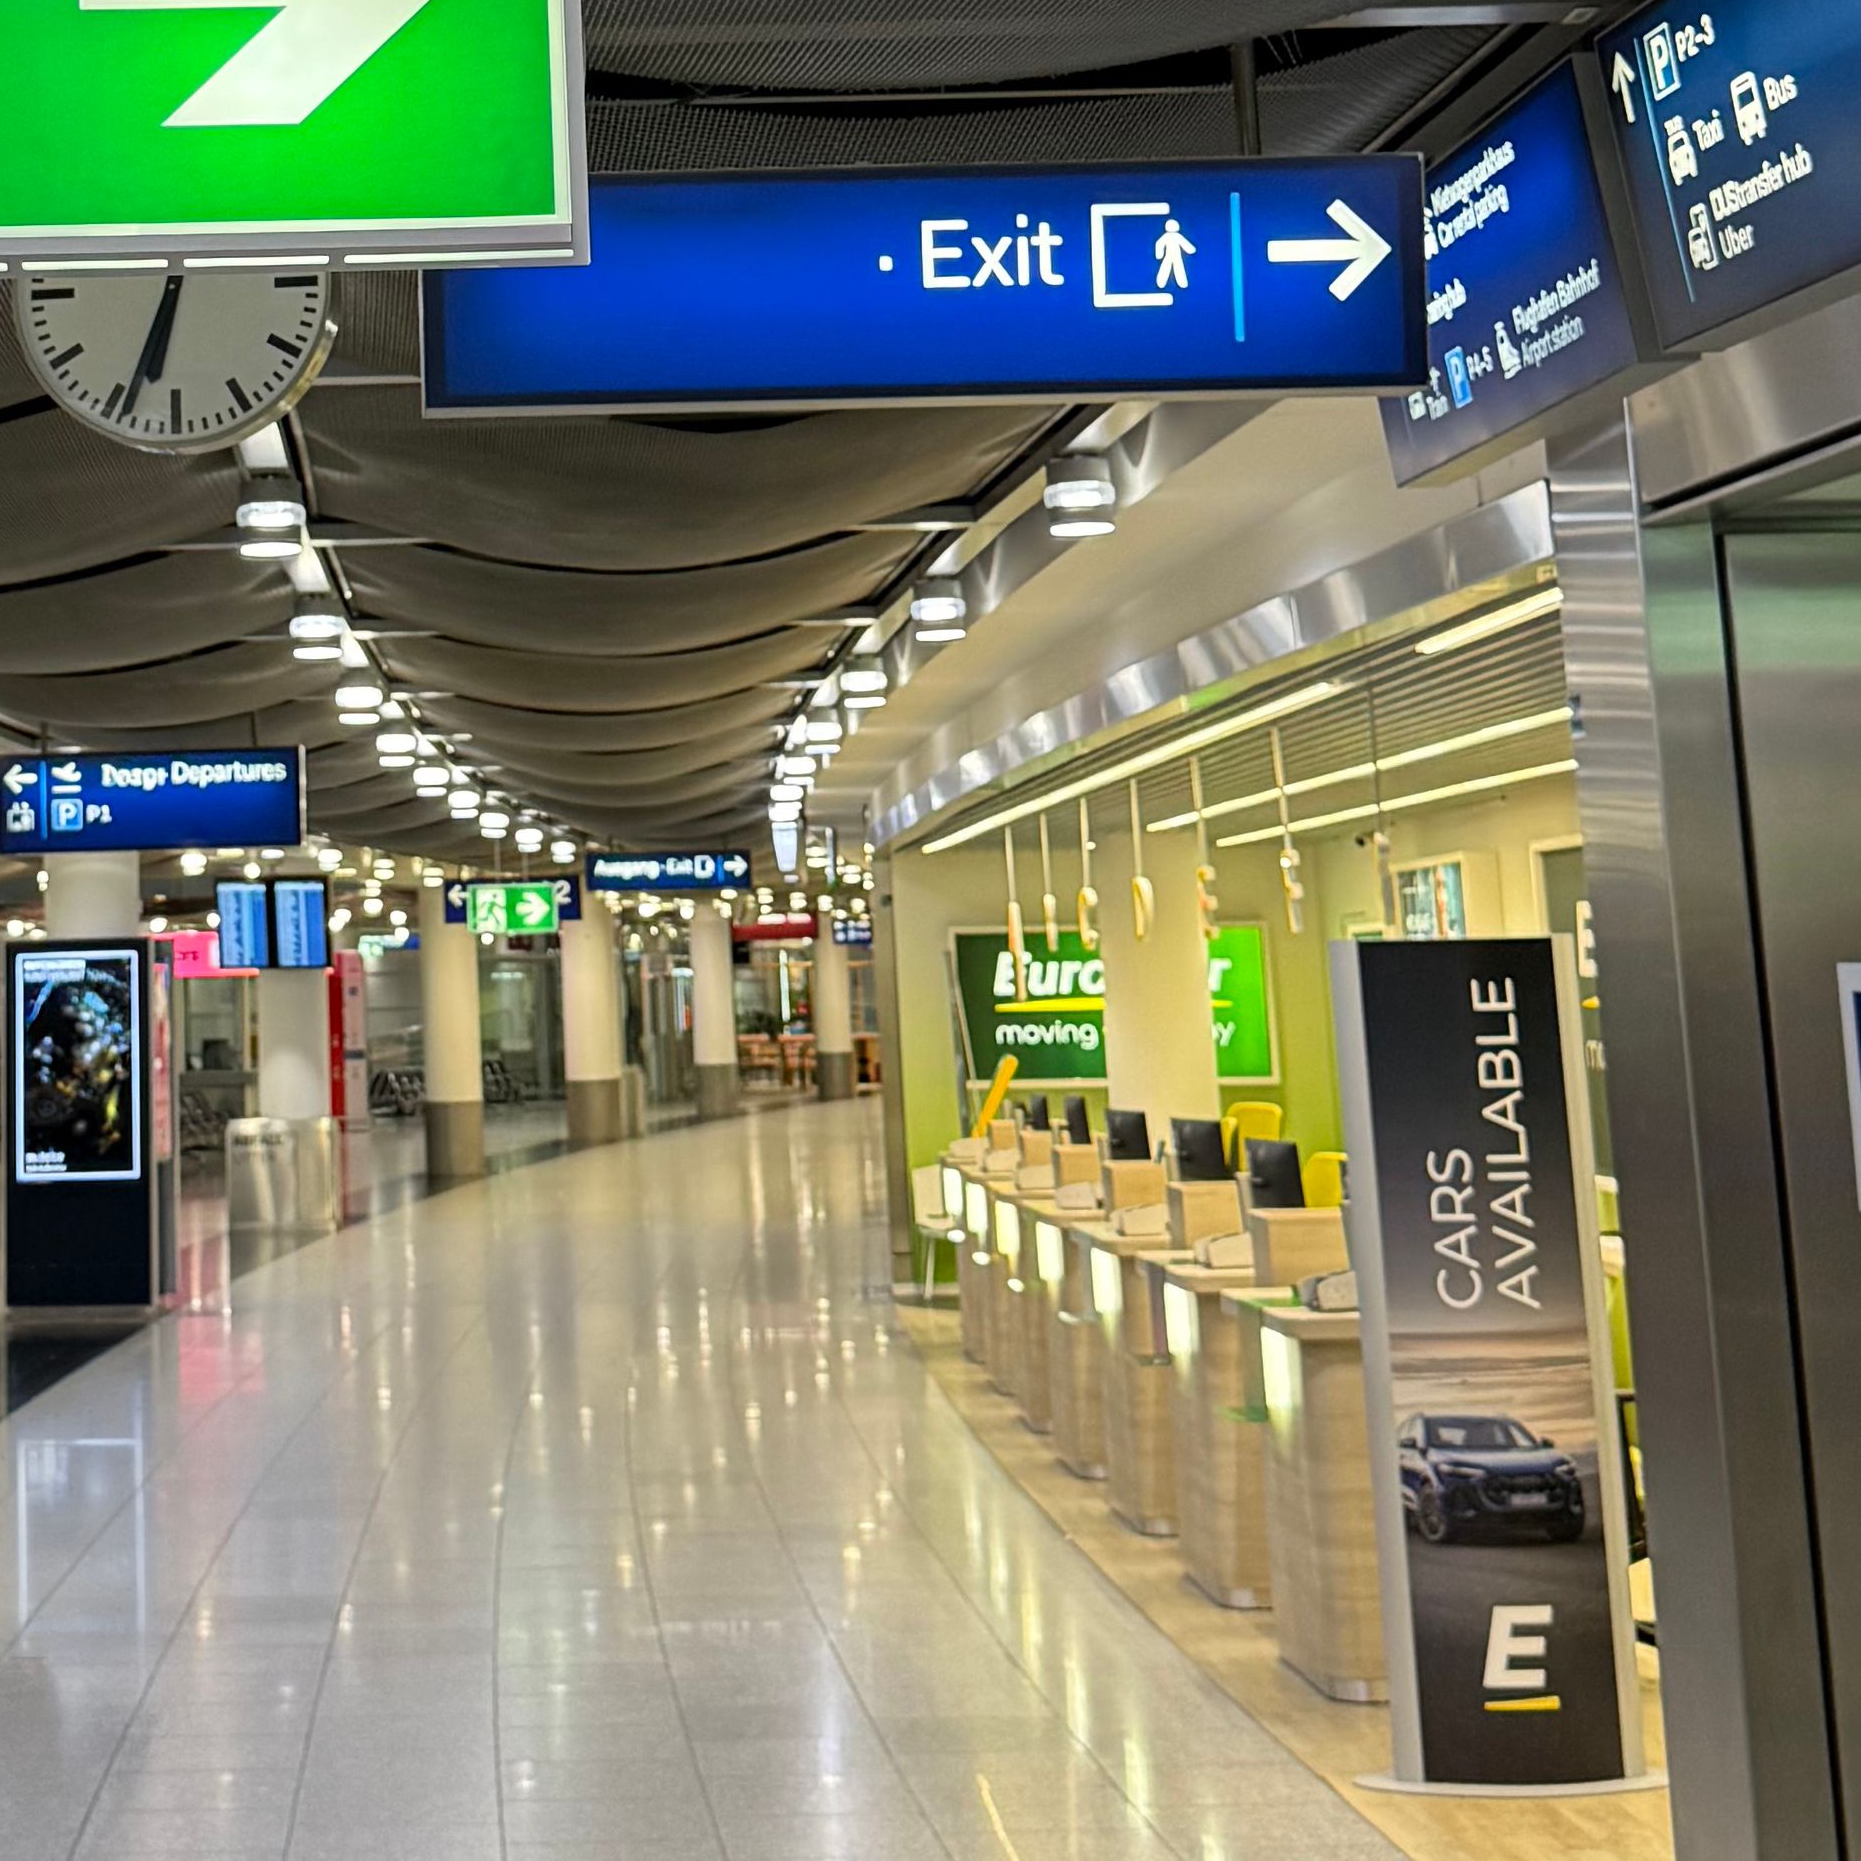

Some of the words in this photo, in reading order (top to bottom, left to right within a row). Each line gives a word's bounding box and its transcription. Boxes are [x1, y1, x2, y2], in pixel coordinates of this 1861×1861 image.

[1675, 14, 1716, 62] P2-3
[1763, 74, 1798, 111] Bus
[1692, 109, 1725, 151] Taxi
[920, 213, 1065, 290] Exit
[1718, 225, 1755, 259] Uber
[1556, 258, 1601, 309] Bahnhof
[171, 760, 287, 789] Departures
[995, 1020, 1100, 1051] moving
[1470, 976, 1542, 1312] AVAILABLE
[1426, 1145, 1484, 1312] CARS
